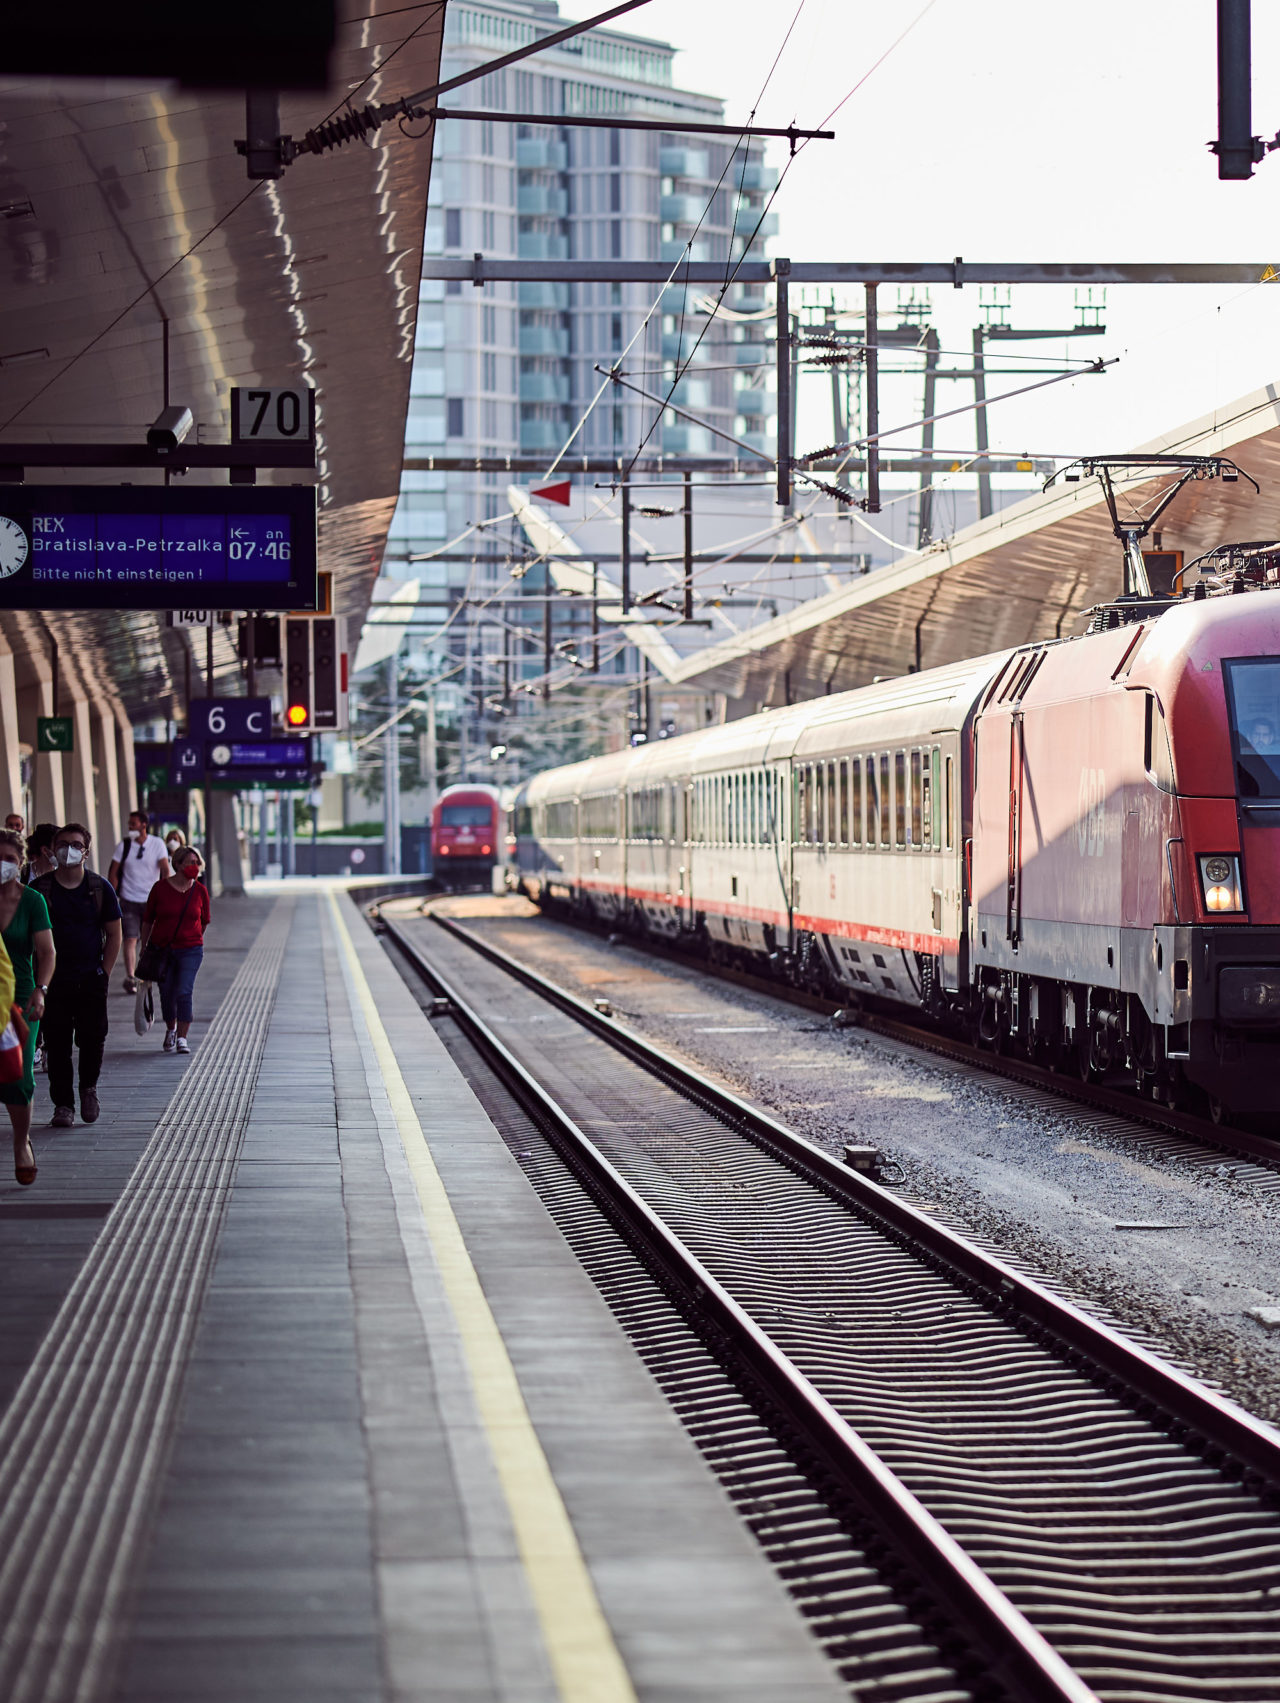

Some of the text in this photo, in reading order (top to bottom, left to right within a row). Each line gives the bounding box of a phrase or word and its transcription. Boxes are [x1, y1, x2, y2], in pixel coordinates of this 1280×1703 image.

[247, 391, 301, 436] 70
[32, 517, 65, 533] REX
[265, 529, 284, 539] an
[32, 538, 223, 552] Bratislava-Petrzalka
[229, 541, 291, 560] 07:46
[32, 568, 70, 580] Bitte
[74, 568, 112, 580] nicht
[117, 568, 195, 582] einsteigen
[207, 706, 226, 734] 6
